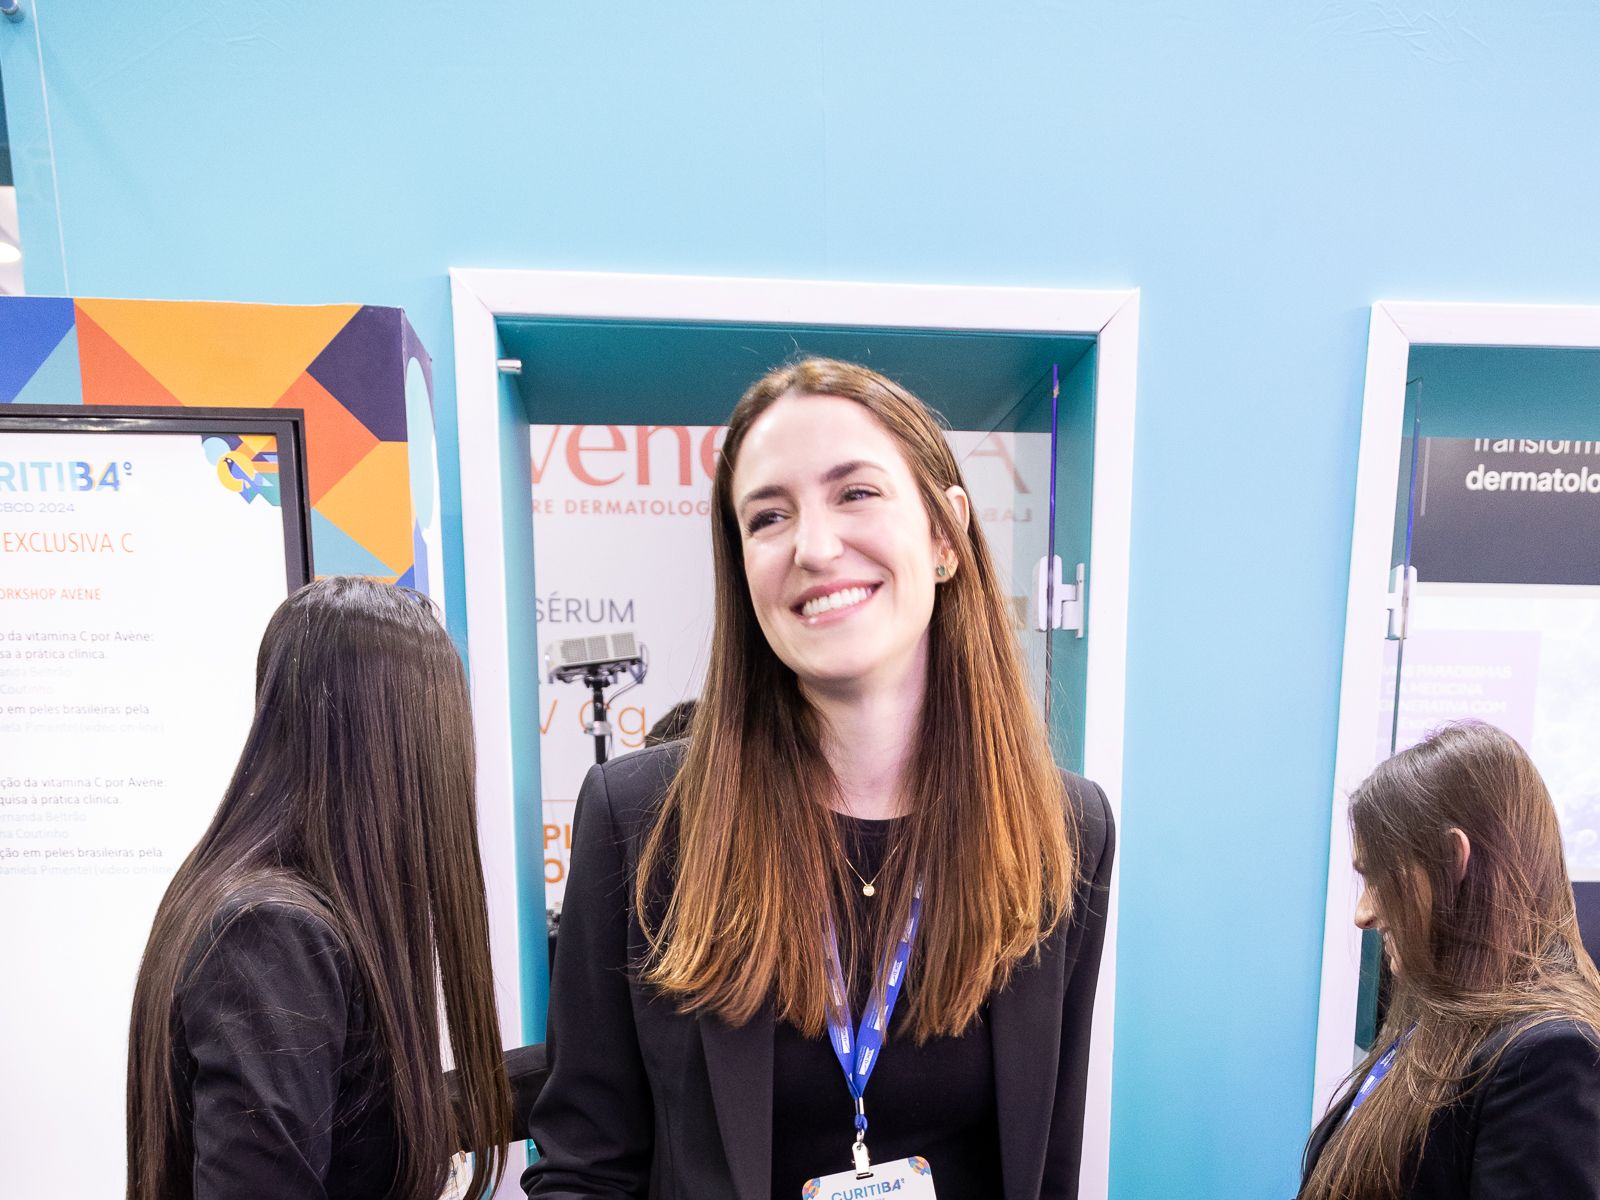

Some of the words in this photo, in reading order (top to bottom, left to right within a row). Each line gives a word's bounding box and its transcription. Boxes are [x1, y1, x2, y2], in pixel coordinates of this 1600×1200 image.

[1466, 464, 1600, 493] dermatolo
[0, 503, 34, 513] BCD
[39, 503, 75, 513] 2024
[4, 532, 114, 553] EXCLUSIVA
[121, 532, 134, 553] C
[25, 630, 76, 641] vitamina
[91, 632, 110, 644] por
[7, 706, 26, 715] em
[63, 703, 121, 715] brasileiras
[125, 704, 150, 716] pela
[24, 777, 38, 788] da
[41, 778, 91, 788] vitamina
[105, 779, 124, 790] por
[23, 850, 41, 858] em
[78, 847, 134, 858] brasileiras
[139, 847, 162, 859] pela
